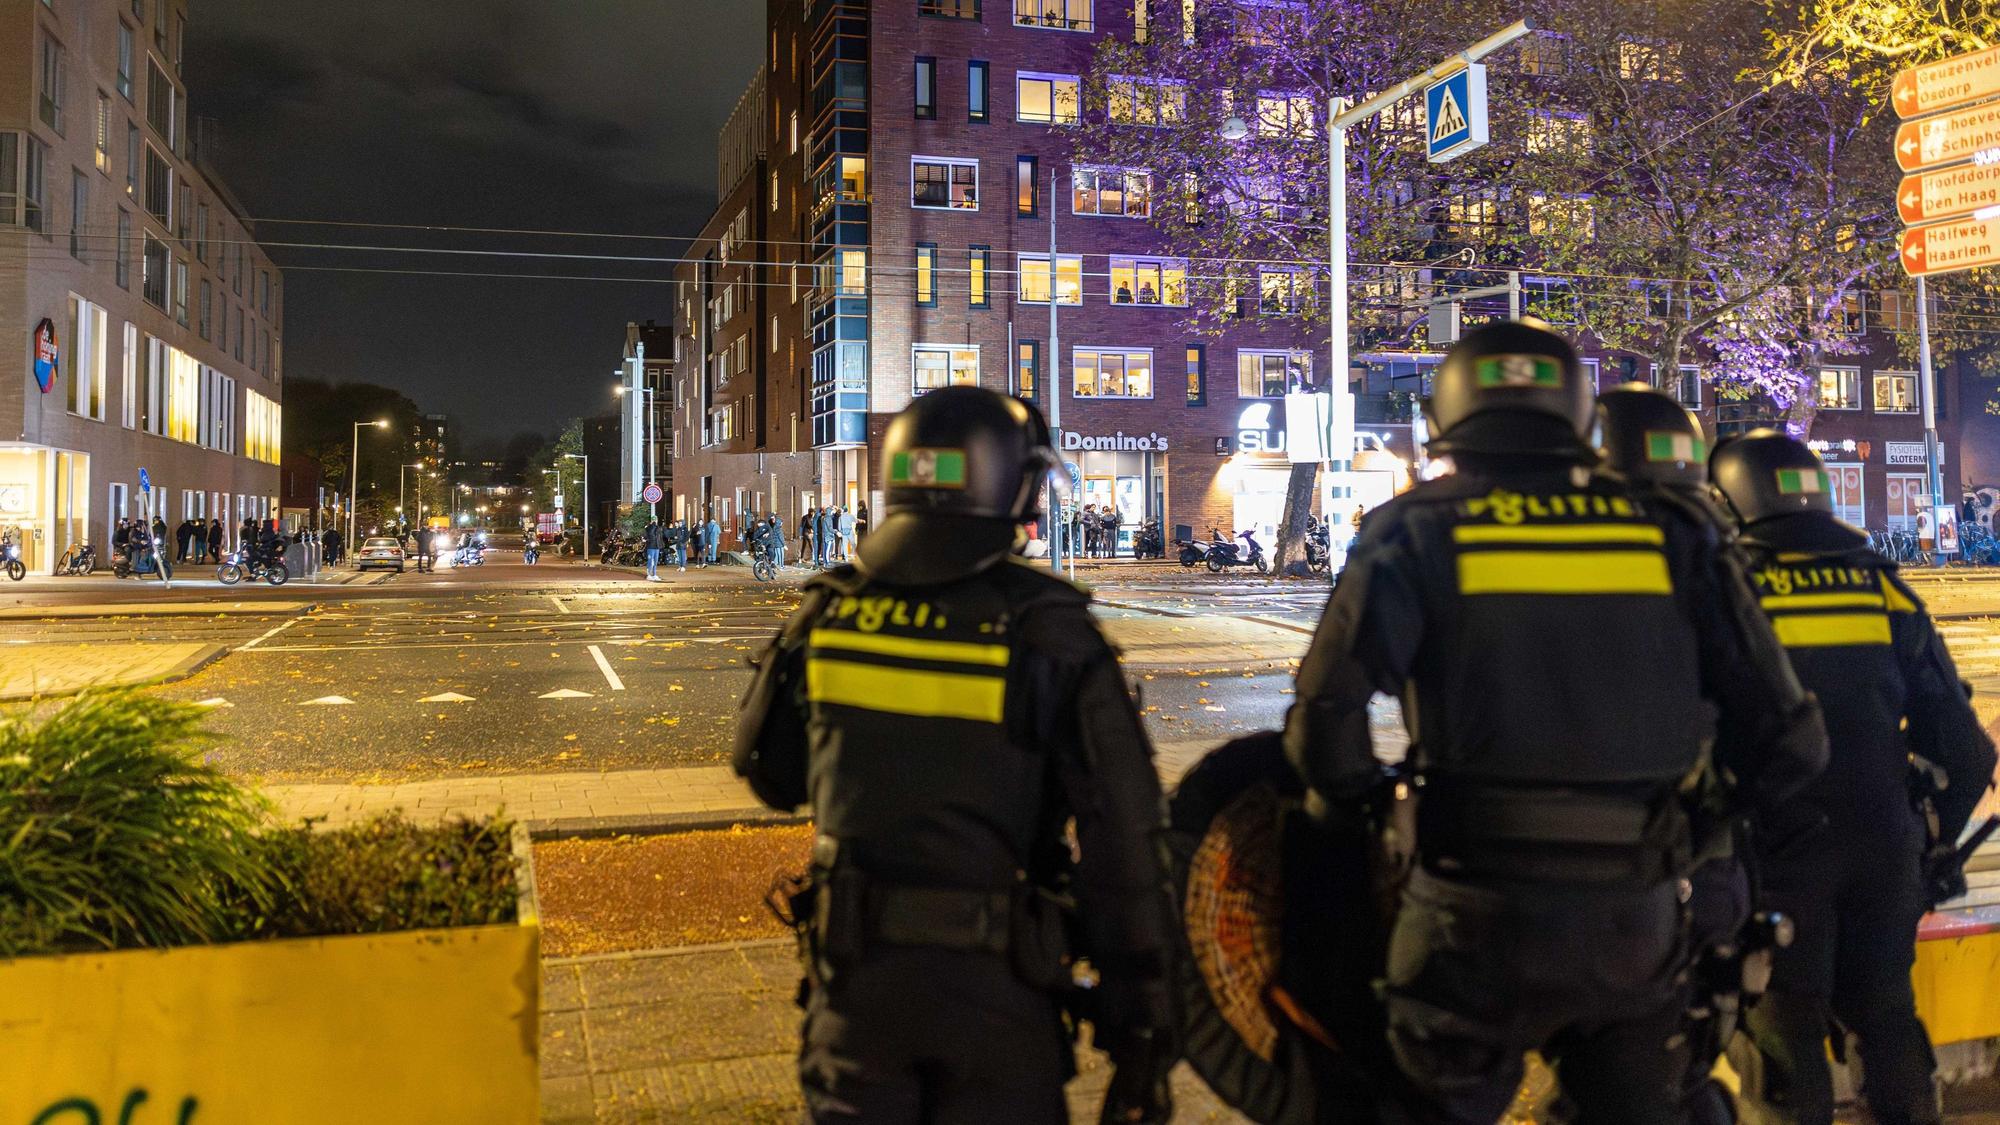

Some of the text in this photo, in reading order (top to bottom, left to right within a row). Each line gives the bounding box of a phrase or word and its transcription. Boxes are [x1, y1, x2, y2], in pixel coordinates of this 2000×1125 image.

[1920, 51, 2000, 83] Geuzenvel
[1920, 82, 1972, 104] Osdorp
[1925, 189, 1997, 212] Den Haag
[1927, 224, 1987, 244] Halfweg
[1928, 243, 1992, 263] Haarlem
[1064, 431, 1169, 451] Domino's
[1890, 455, 1927, 464] SLOTERM
